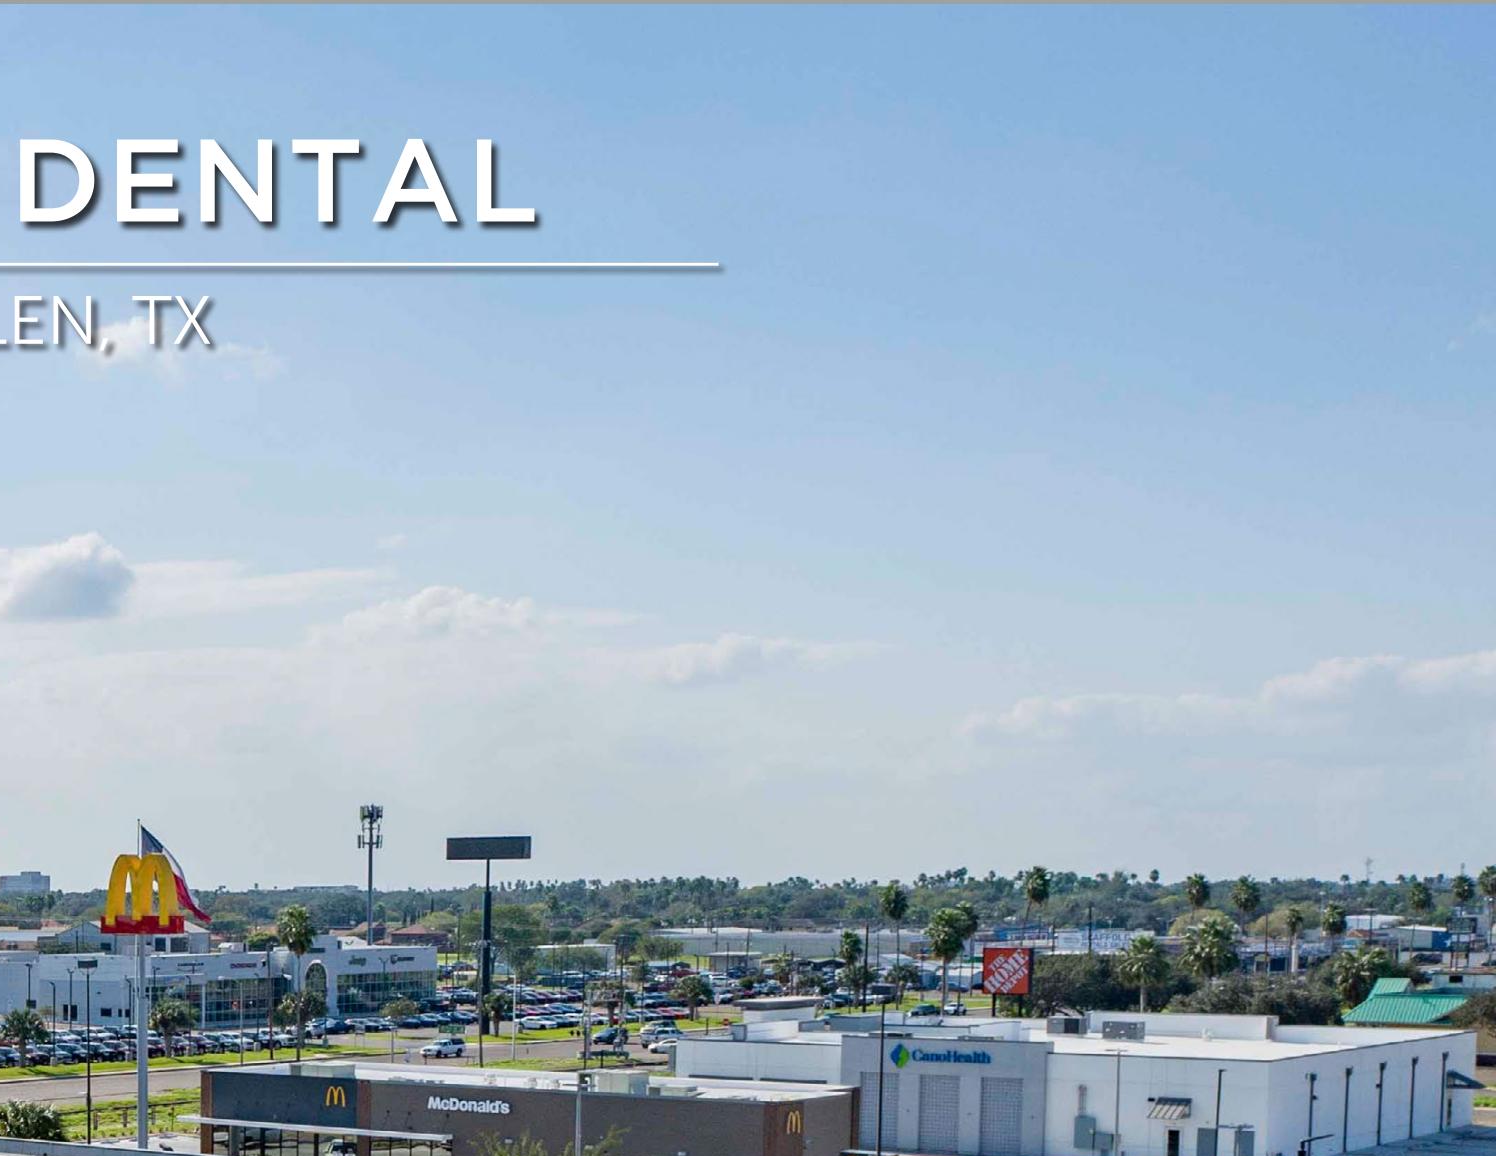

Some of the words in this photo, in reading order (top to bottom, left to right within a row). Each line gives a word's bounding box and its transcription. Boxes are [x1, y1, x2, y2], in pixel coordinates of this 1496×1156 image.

[984, 949, 1029, 993] HOME
[988, 955, 1005, 972] THE
[1000, 967, 1028, 994] DEPOT
[912, 1048, 992, 1064] CanoHealth
[427, 1096, 511, 1115] McDonald's
